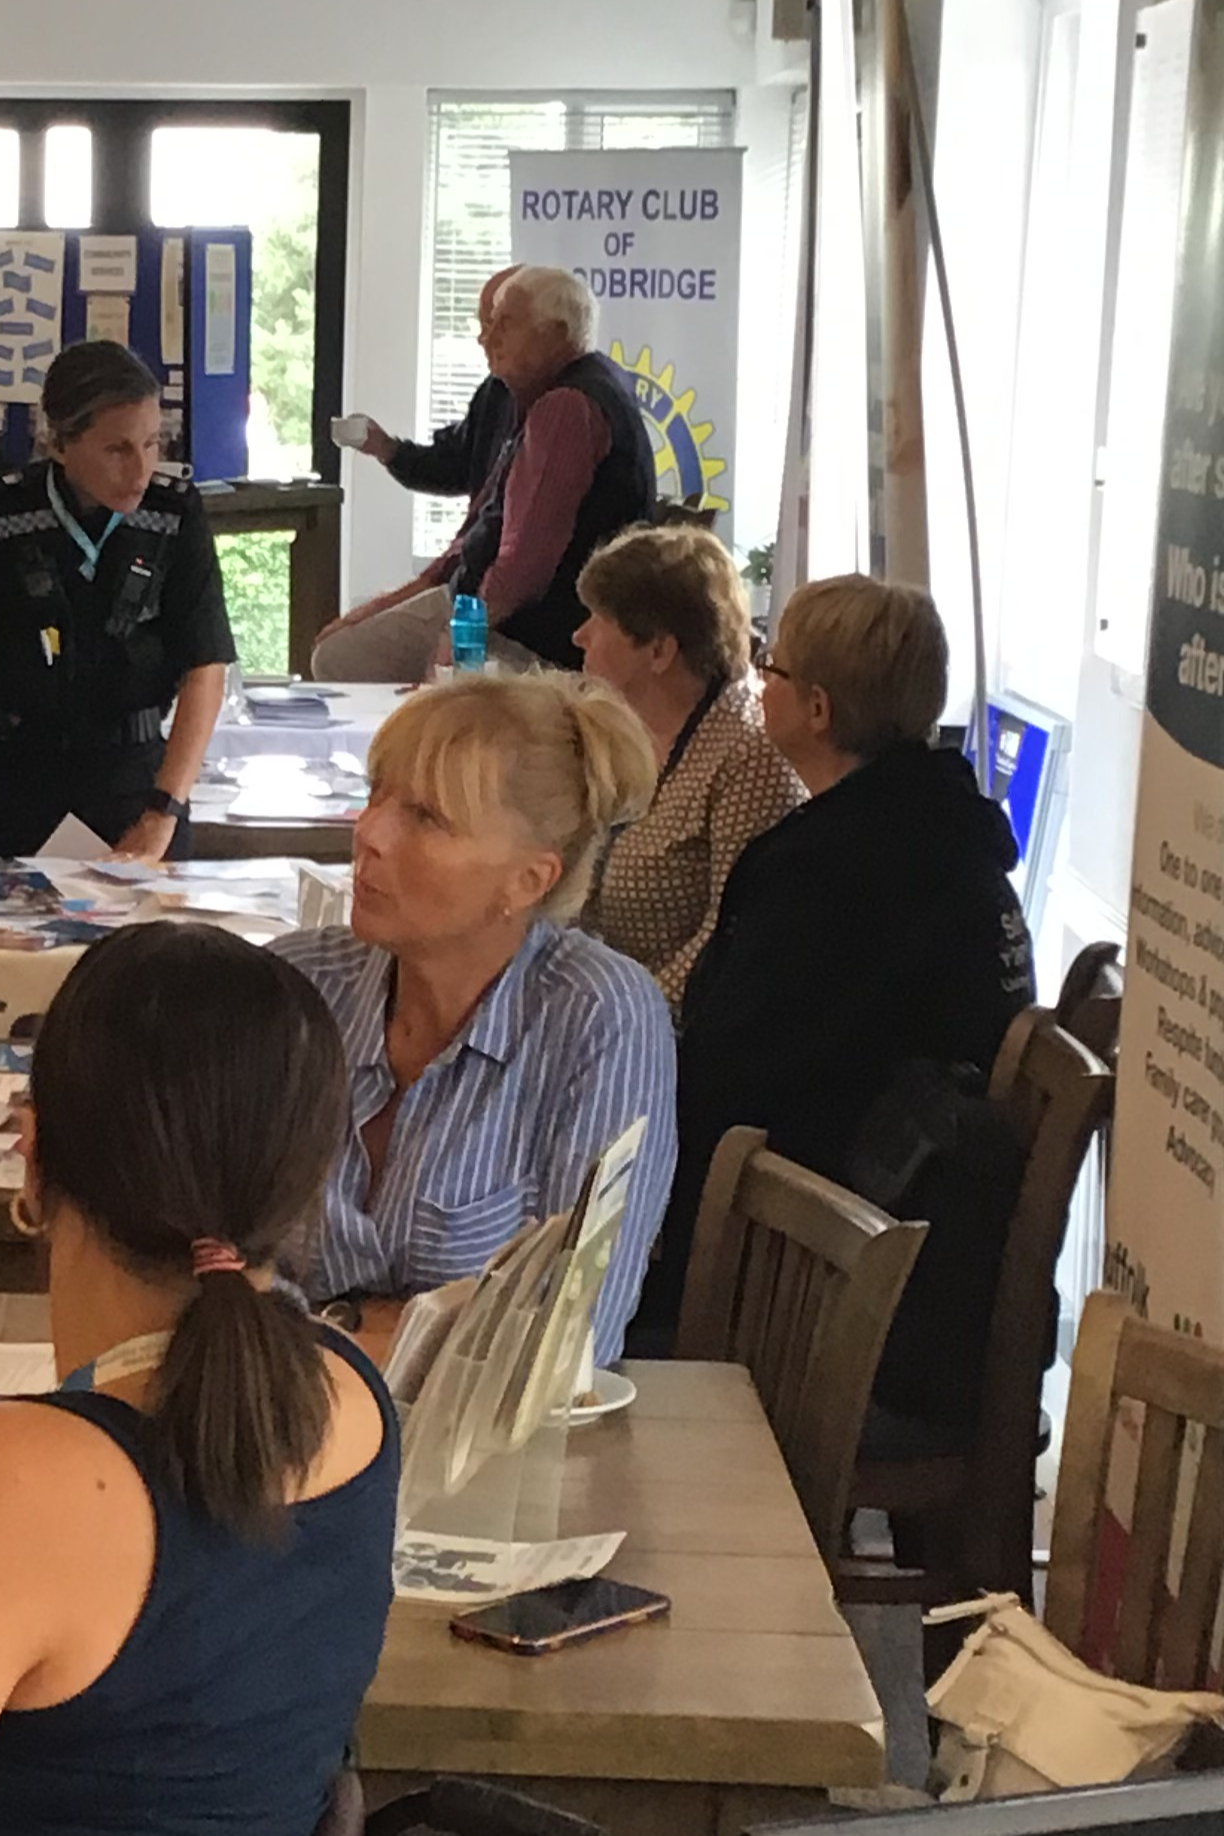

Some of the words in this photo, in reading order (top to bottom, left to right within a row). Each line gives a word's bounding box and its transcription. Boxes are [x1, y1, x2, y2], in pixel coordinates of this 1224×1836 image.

[522, 189, 633, 221] ROTARY
[641, 188, 719, 221] CLUB
[603, 231, 635, 257] OF
[1167, 544, 1206, 607] Who
[1160, 840, 1181, 881] One
[1132, 884, 1191, 946] nformation,
[1103, 1240, 1150, 1321] uffolk
